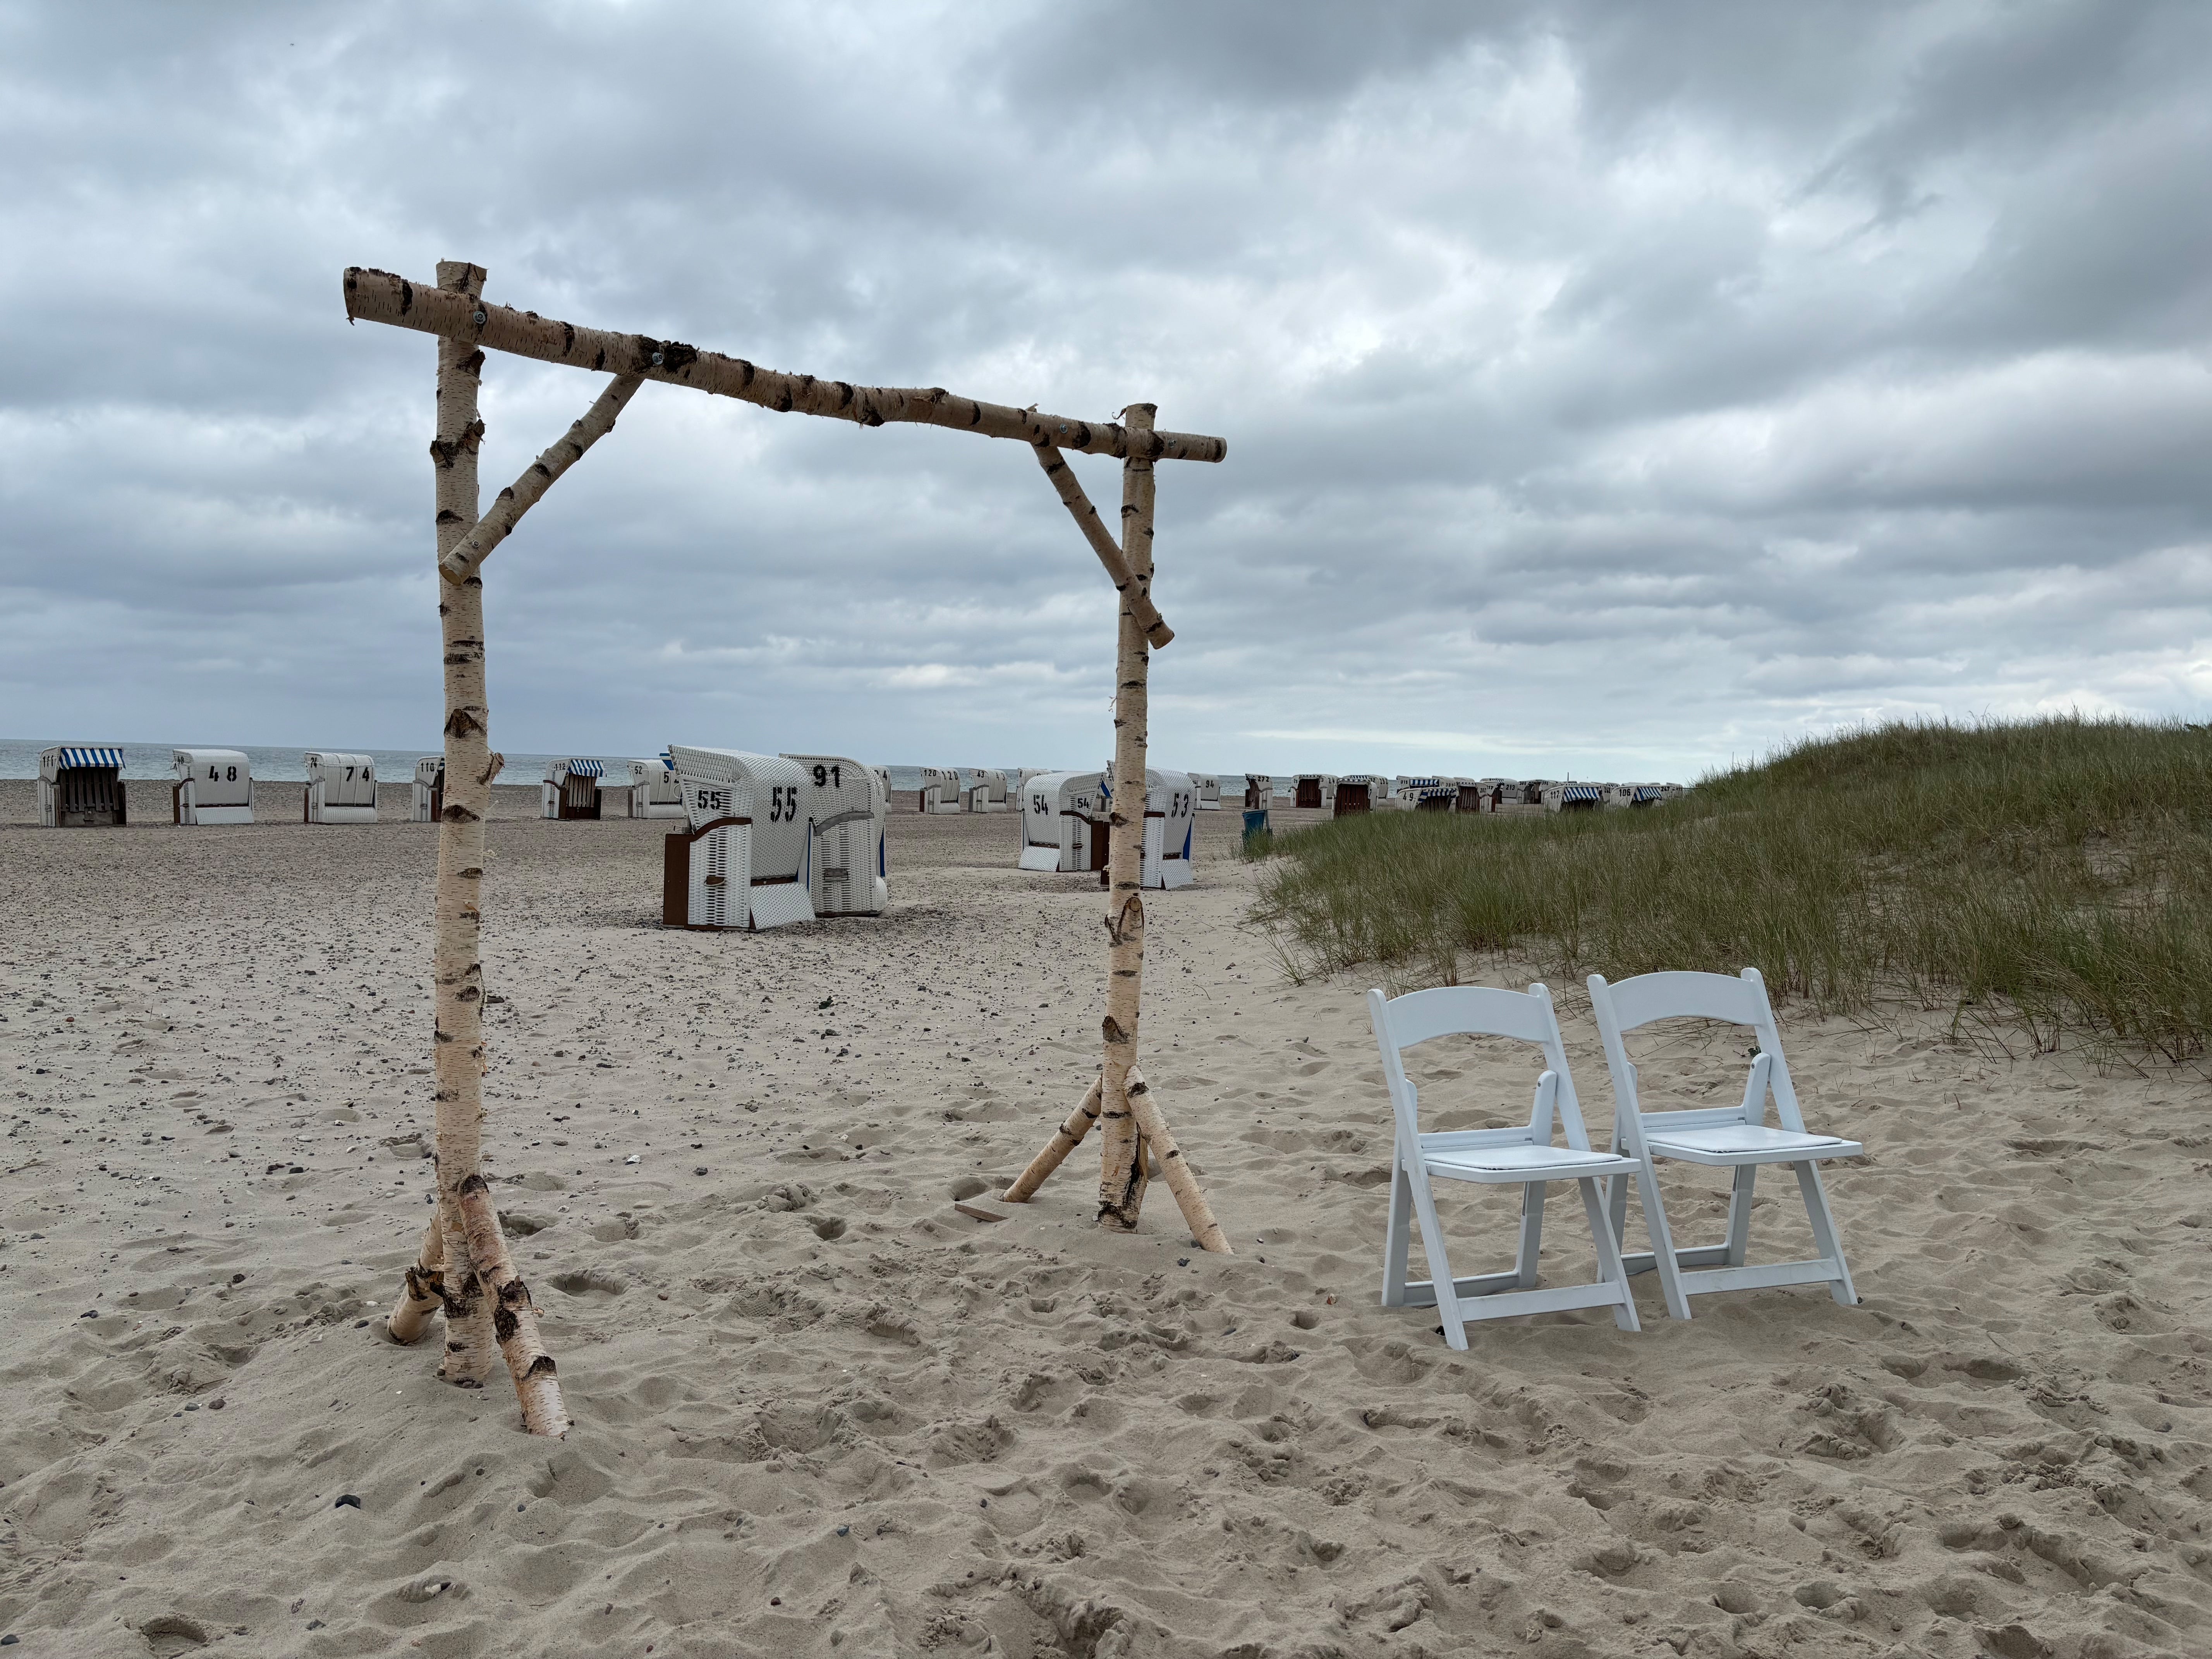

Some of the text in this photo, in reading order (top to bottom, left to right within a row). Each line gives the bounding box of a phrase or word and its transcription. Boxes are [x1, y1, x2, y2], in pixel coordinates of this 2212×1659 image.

[178, 756, 184, 764] 48
[421, 763, 434, 772] 110
[635, 766, 642, 774] 52
[209, 766, 237, 781] 48
[346, 767, 369, 781] 74
[814, 764, 840, 788] 91
[941, 771, 958, 780] 120
[1206, 780, 1214, 788] 94
[1403, 792, 1413, 801] 49
[1551, 790, 1559, 799] 117
[1620, 788, 1631, 797] 106
[697, 790, 721, 810] 55
[771, 787, 797, 822] 55
[1034, 794, 1048, 815] 54
[1077, 798, 1089, 808] 54
[1171, 792, 1188, 818] 53
